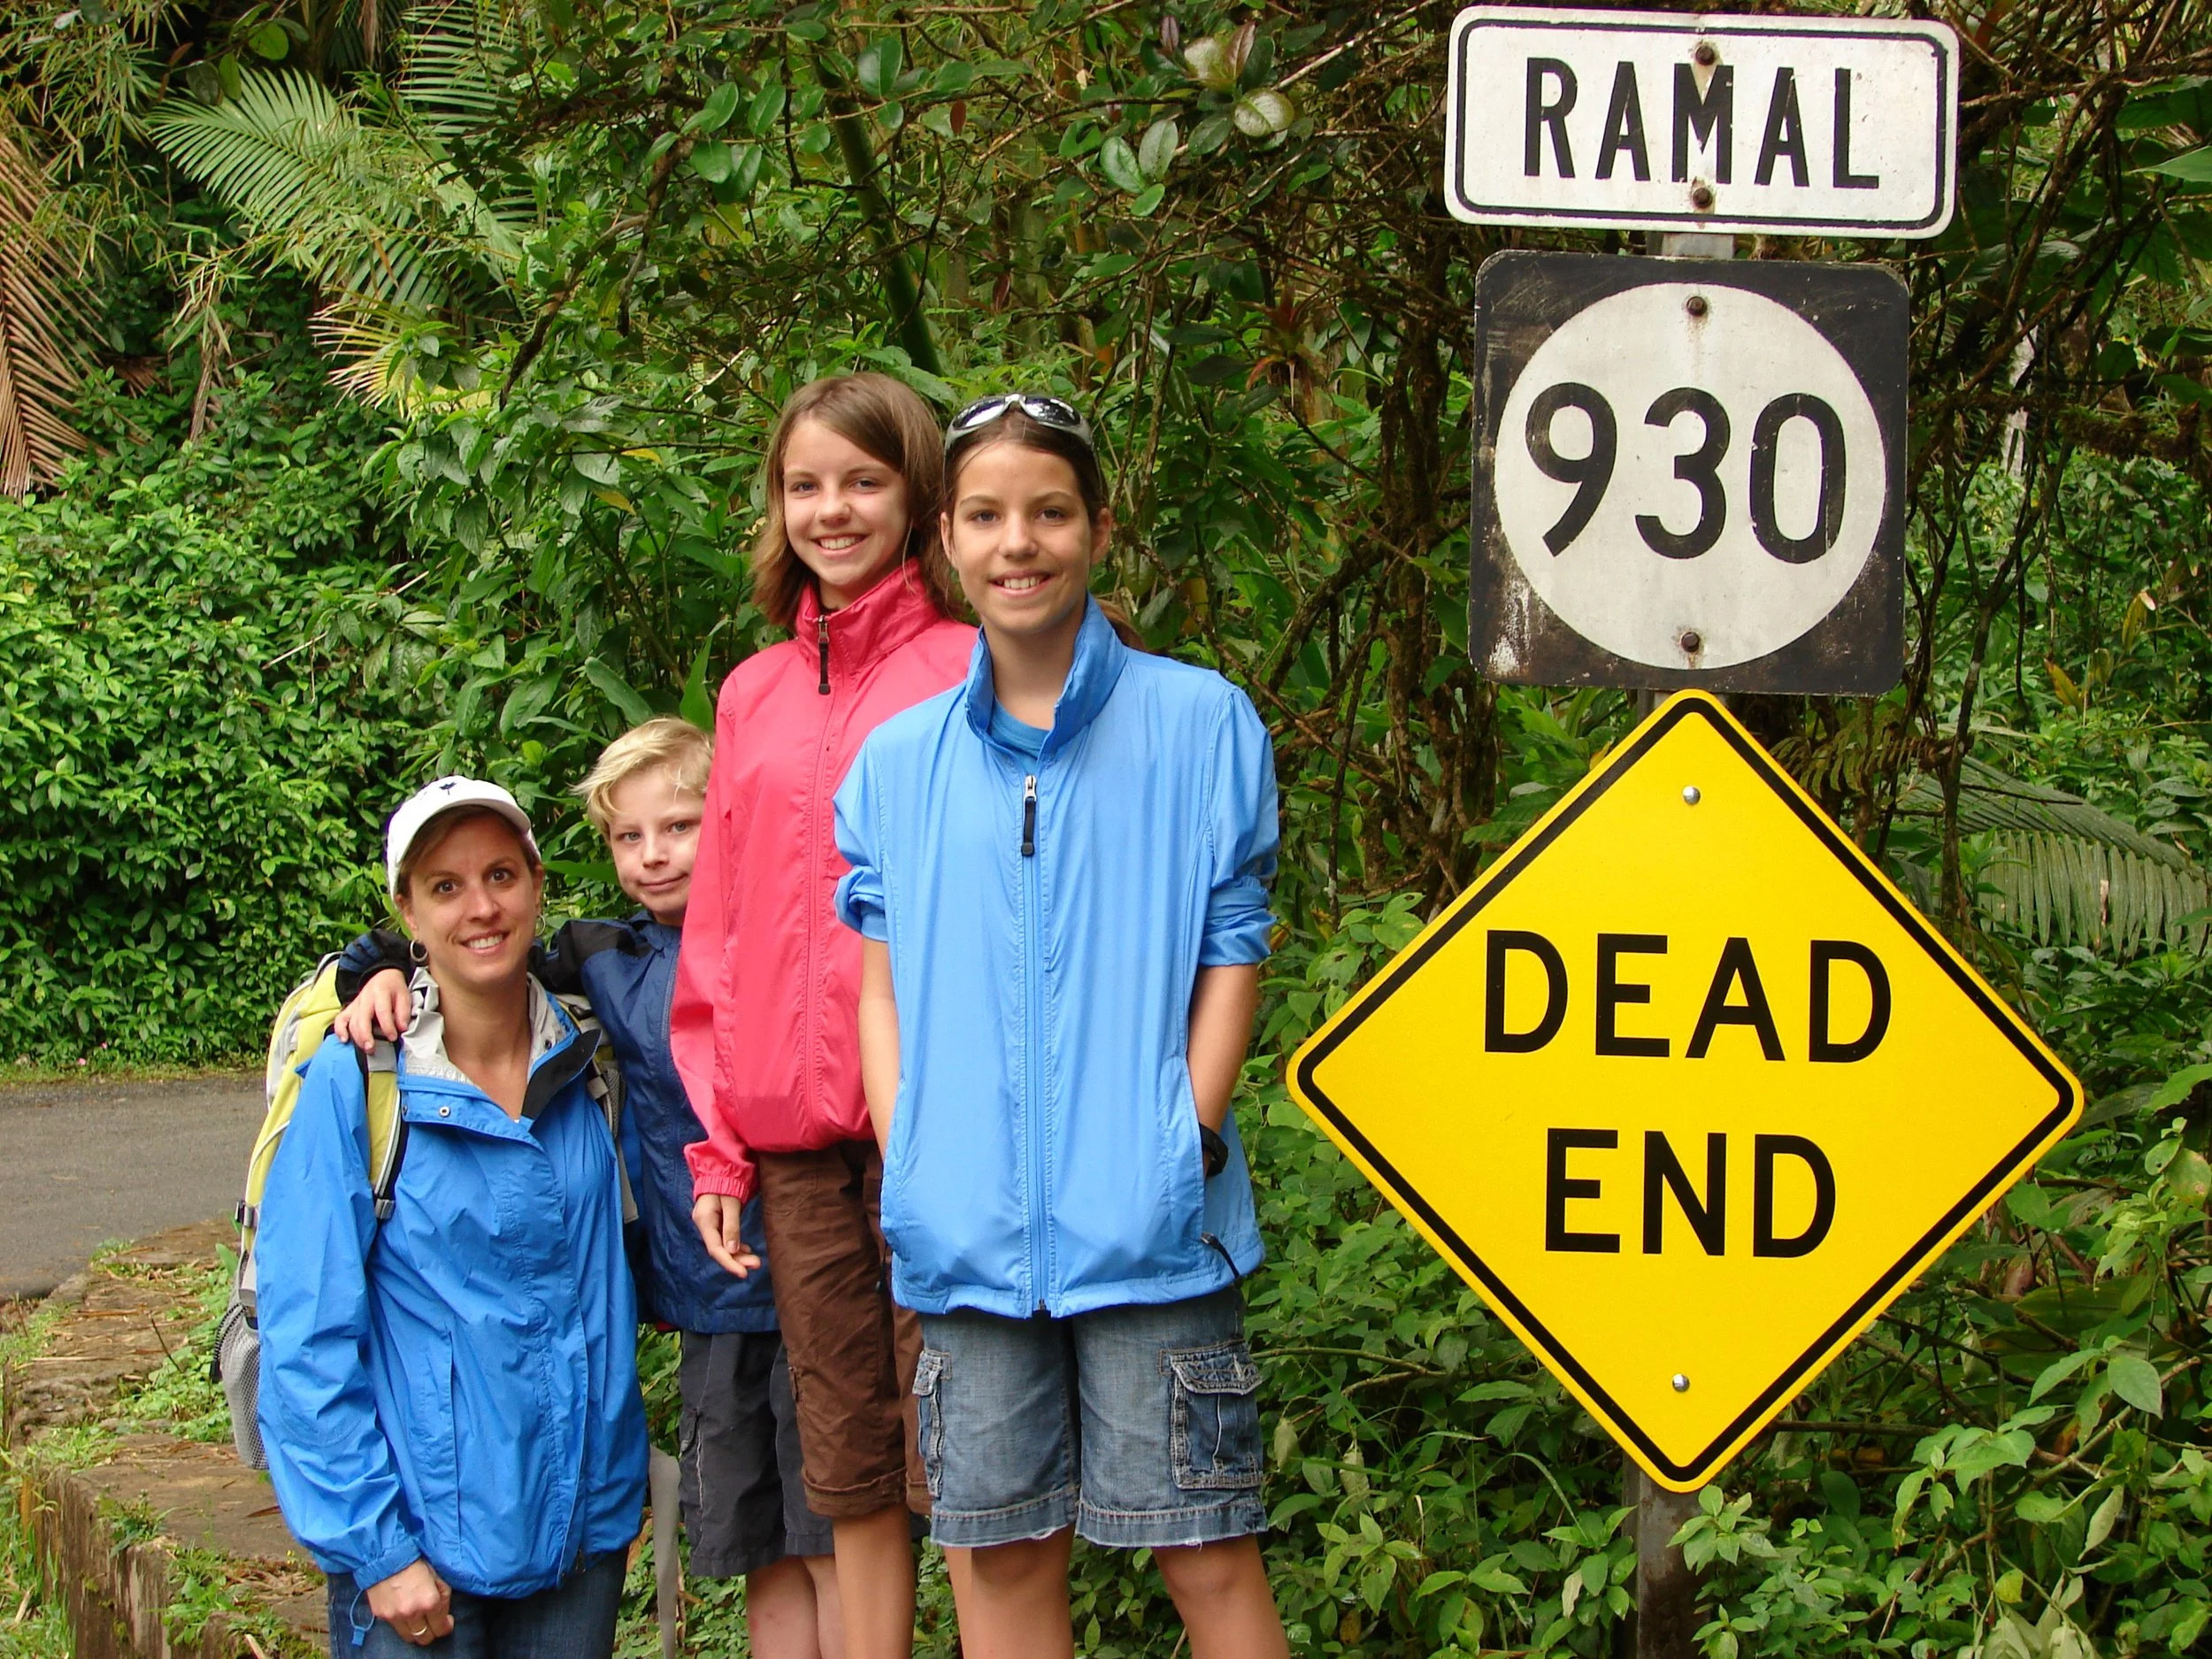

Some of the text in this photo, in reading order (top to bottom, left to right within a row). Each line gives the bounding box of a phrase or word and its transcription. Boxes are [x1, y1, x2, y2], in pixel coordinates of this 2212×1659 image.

[1524, 57, 1879, 189] RAMAL
[1525, 381, 1847, 565] 930
[1484, 929, 1892, 1064] DEAD
[1545, 1127, 1836, 1258] END
